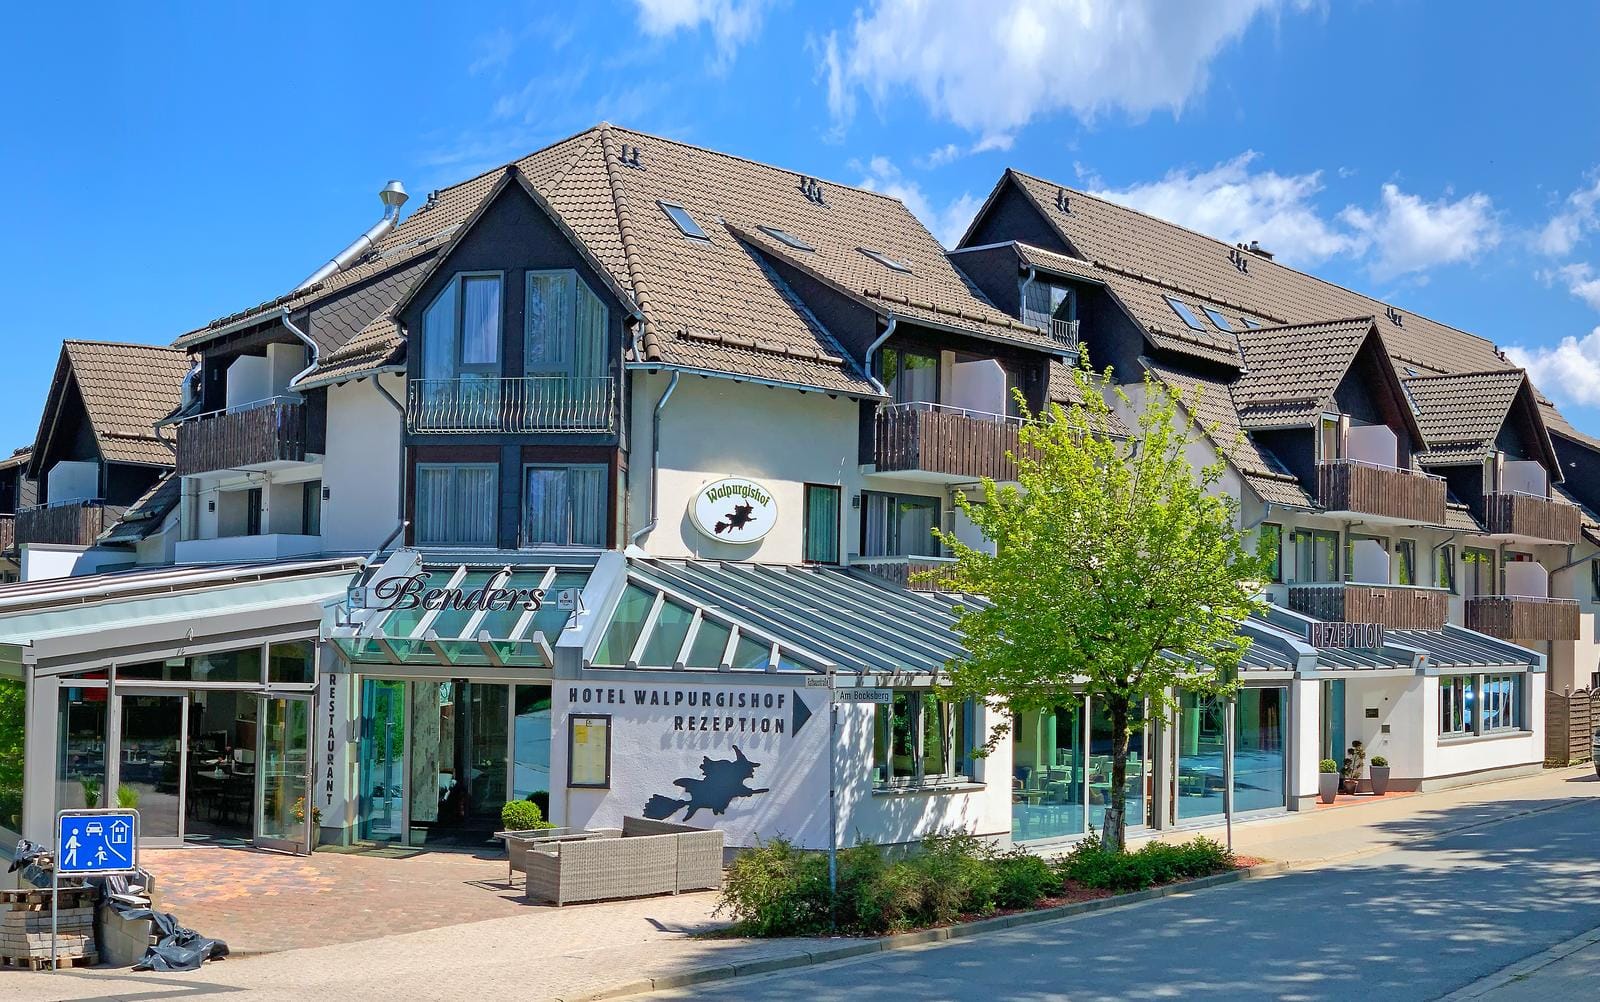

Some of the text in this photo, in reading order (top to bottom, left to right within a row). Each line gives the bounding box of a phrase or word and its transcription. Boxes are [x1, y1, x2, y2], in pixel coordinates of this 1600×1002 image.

[706, 483, 771, 507] Walpurgishof
[374, 571, 545, 613] Benders
[1312, 621, 1385, 649] REZEPTION
[569, 687, 785, 709] HOTEL WALPURGISHOF
[839, 690, 889, 702] Am Bocksberg
[674, 715, 785, 734] REZEPTION
[326, 673, 337, 806] RESTAURANT
